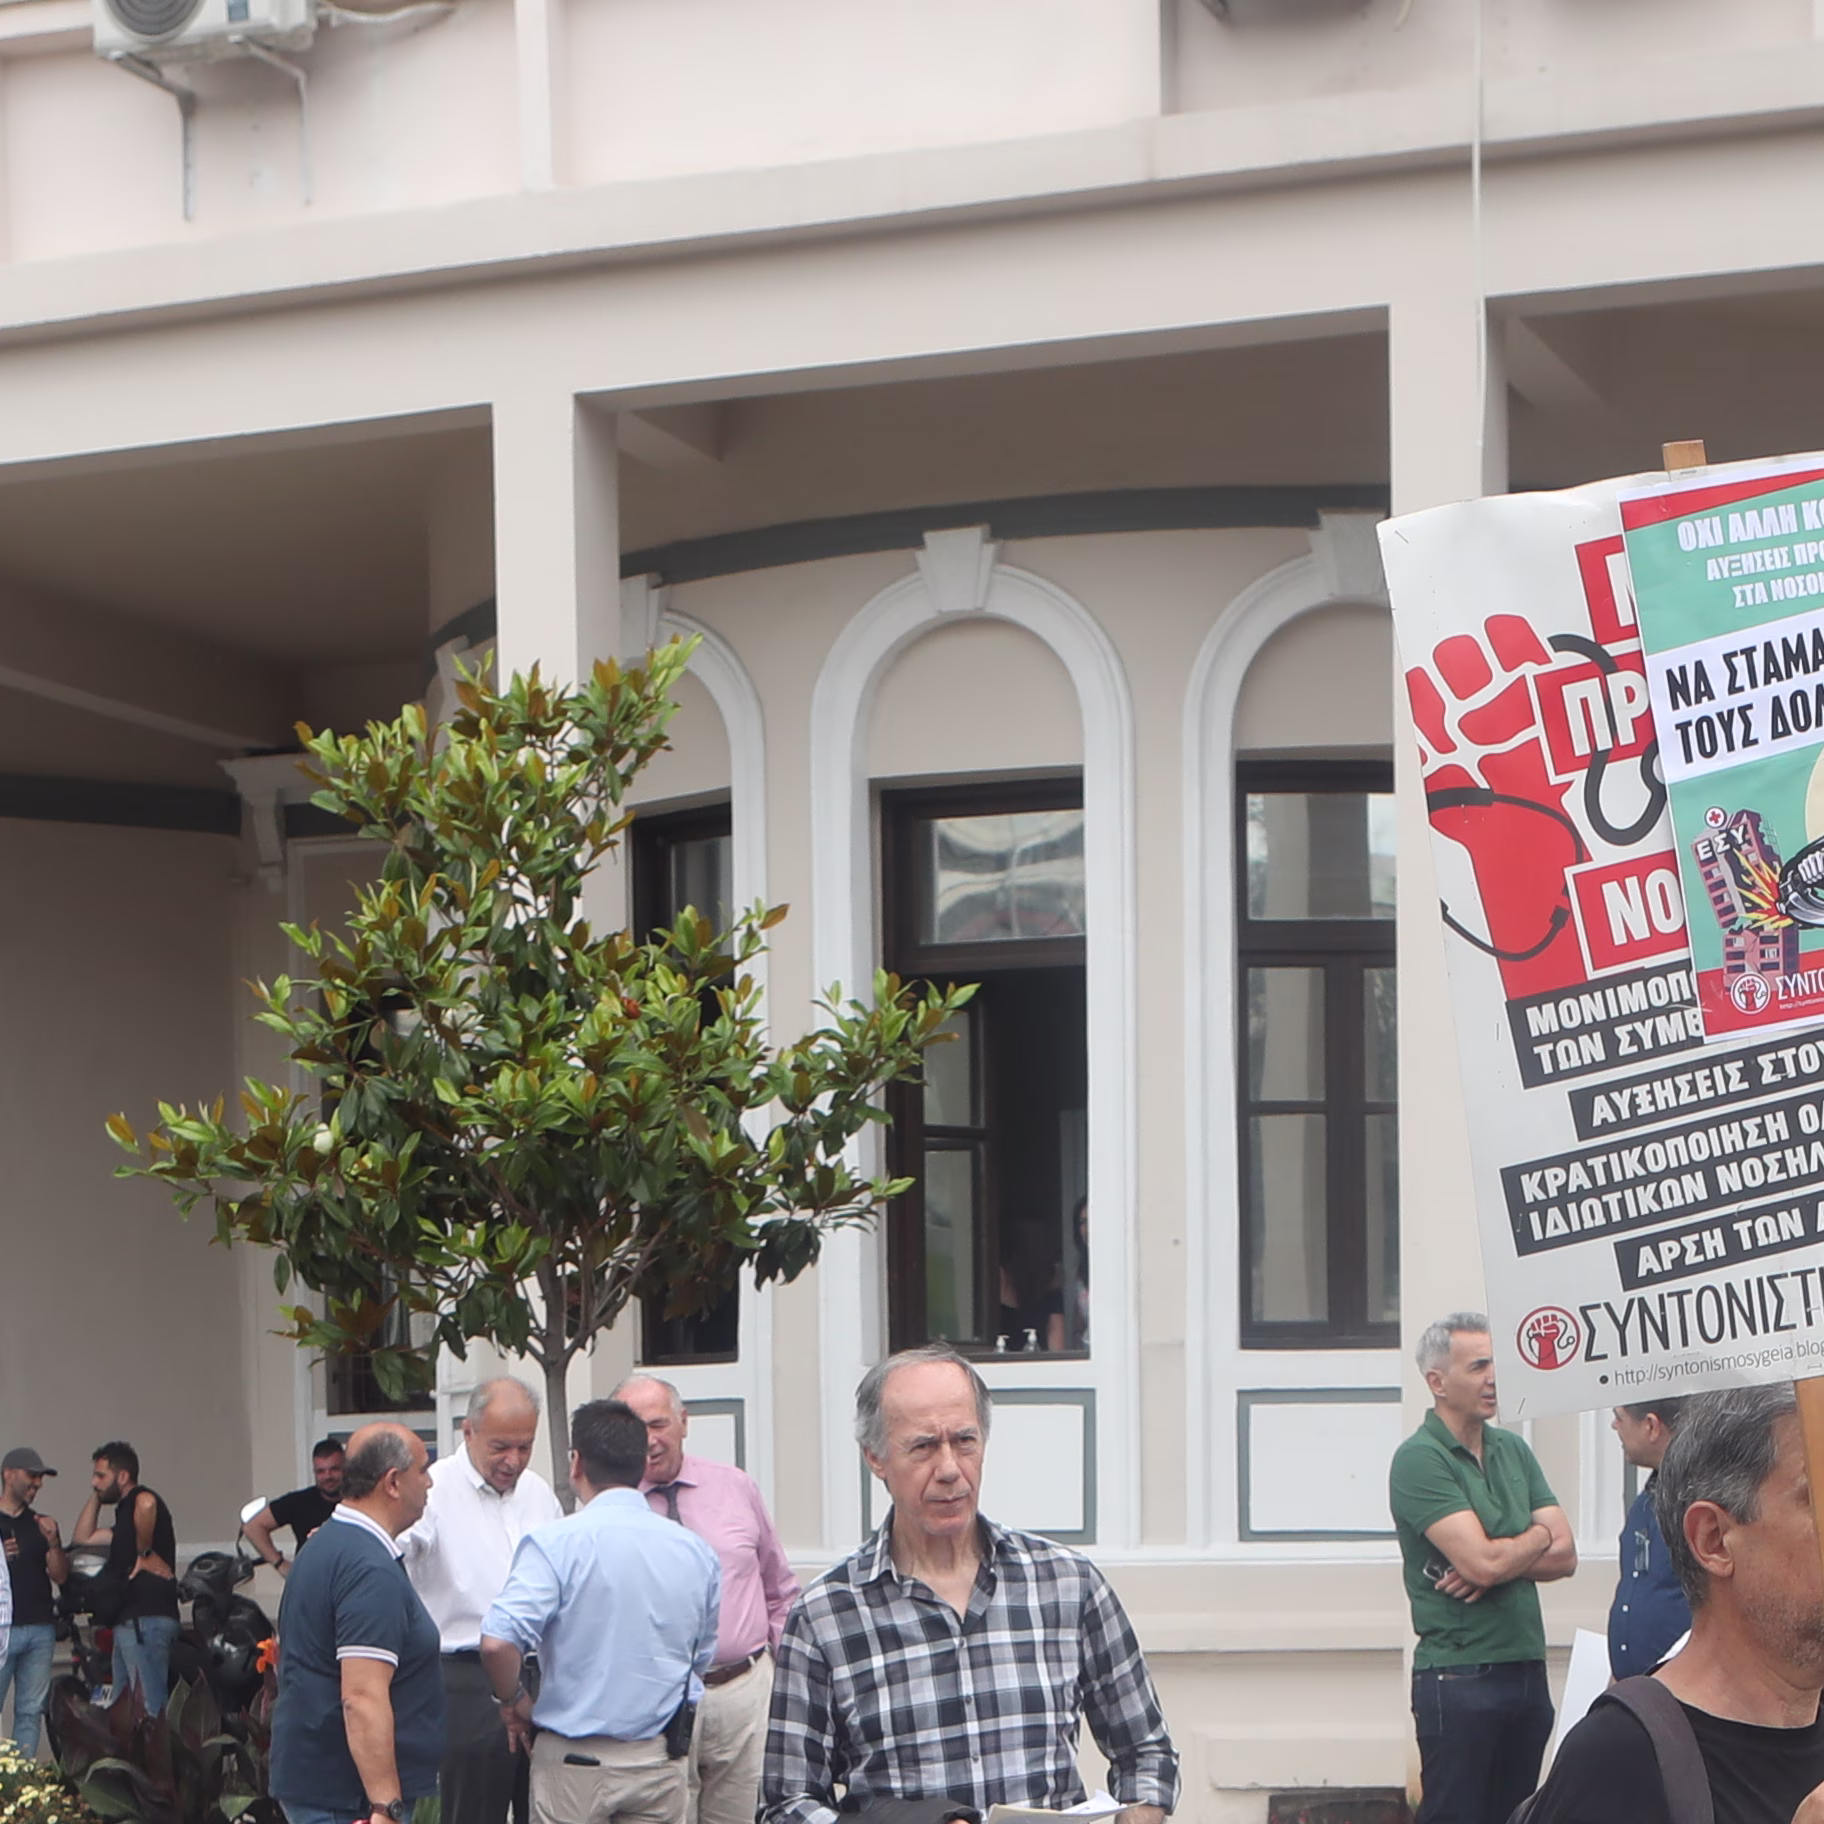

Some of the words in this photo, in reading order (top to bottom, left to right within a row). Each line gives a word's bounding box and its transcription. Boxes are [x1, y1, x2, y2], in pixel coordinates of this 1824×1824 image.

[1677, 515, 1725, 552] ΟΧΙ
[1729, 503, 1798, 544] ΑΛΛΗ
[1707, 546, 1792, 581] ΑΥΞΗΣΕΙΣ
[1733, 582, 1769, 608] ΣΤΑ
[1666, 660, 1716, 712] ΝΑ
[1675, 703, 1760, 765] ΤΟΥΣ
[1696, 824, 1749, 861] ΕΣΥ
[1533, 1031, 1606, 1075] ΤΩΝ
[1592, 1061, 1749, 1127] ΑΥΞΗΣΕΙΣ
[1520, 1110, 1790, 1204] ΚΡΑΤΙΚΟΠΟΙΗΣΗ
[1529, 1171, 1708, 1241] ΙΔΙΩΤΙΚΩΝ
[1637, 1227, 1726, 1279] ΑΡΣΗ
[1734, 1208, 1804, 1254] ΤΩΝ
